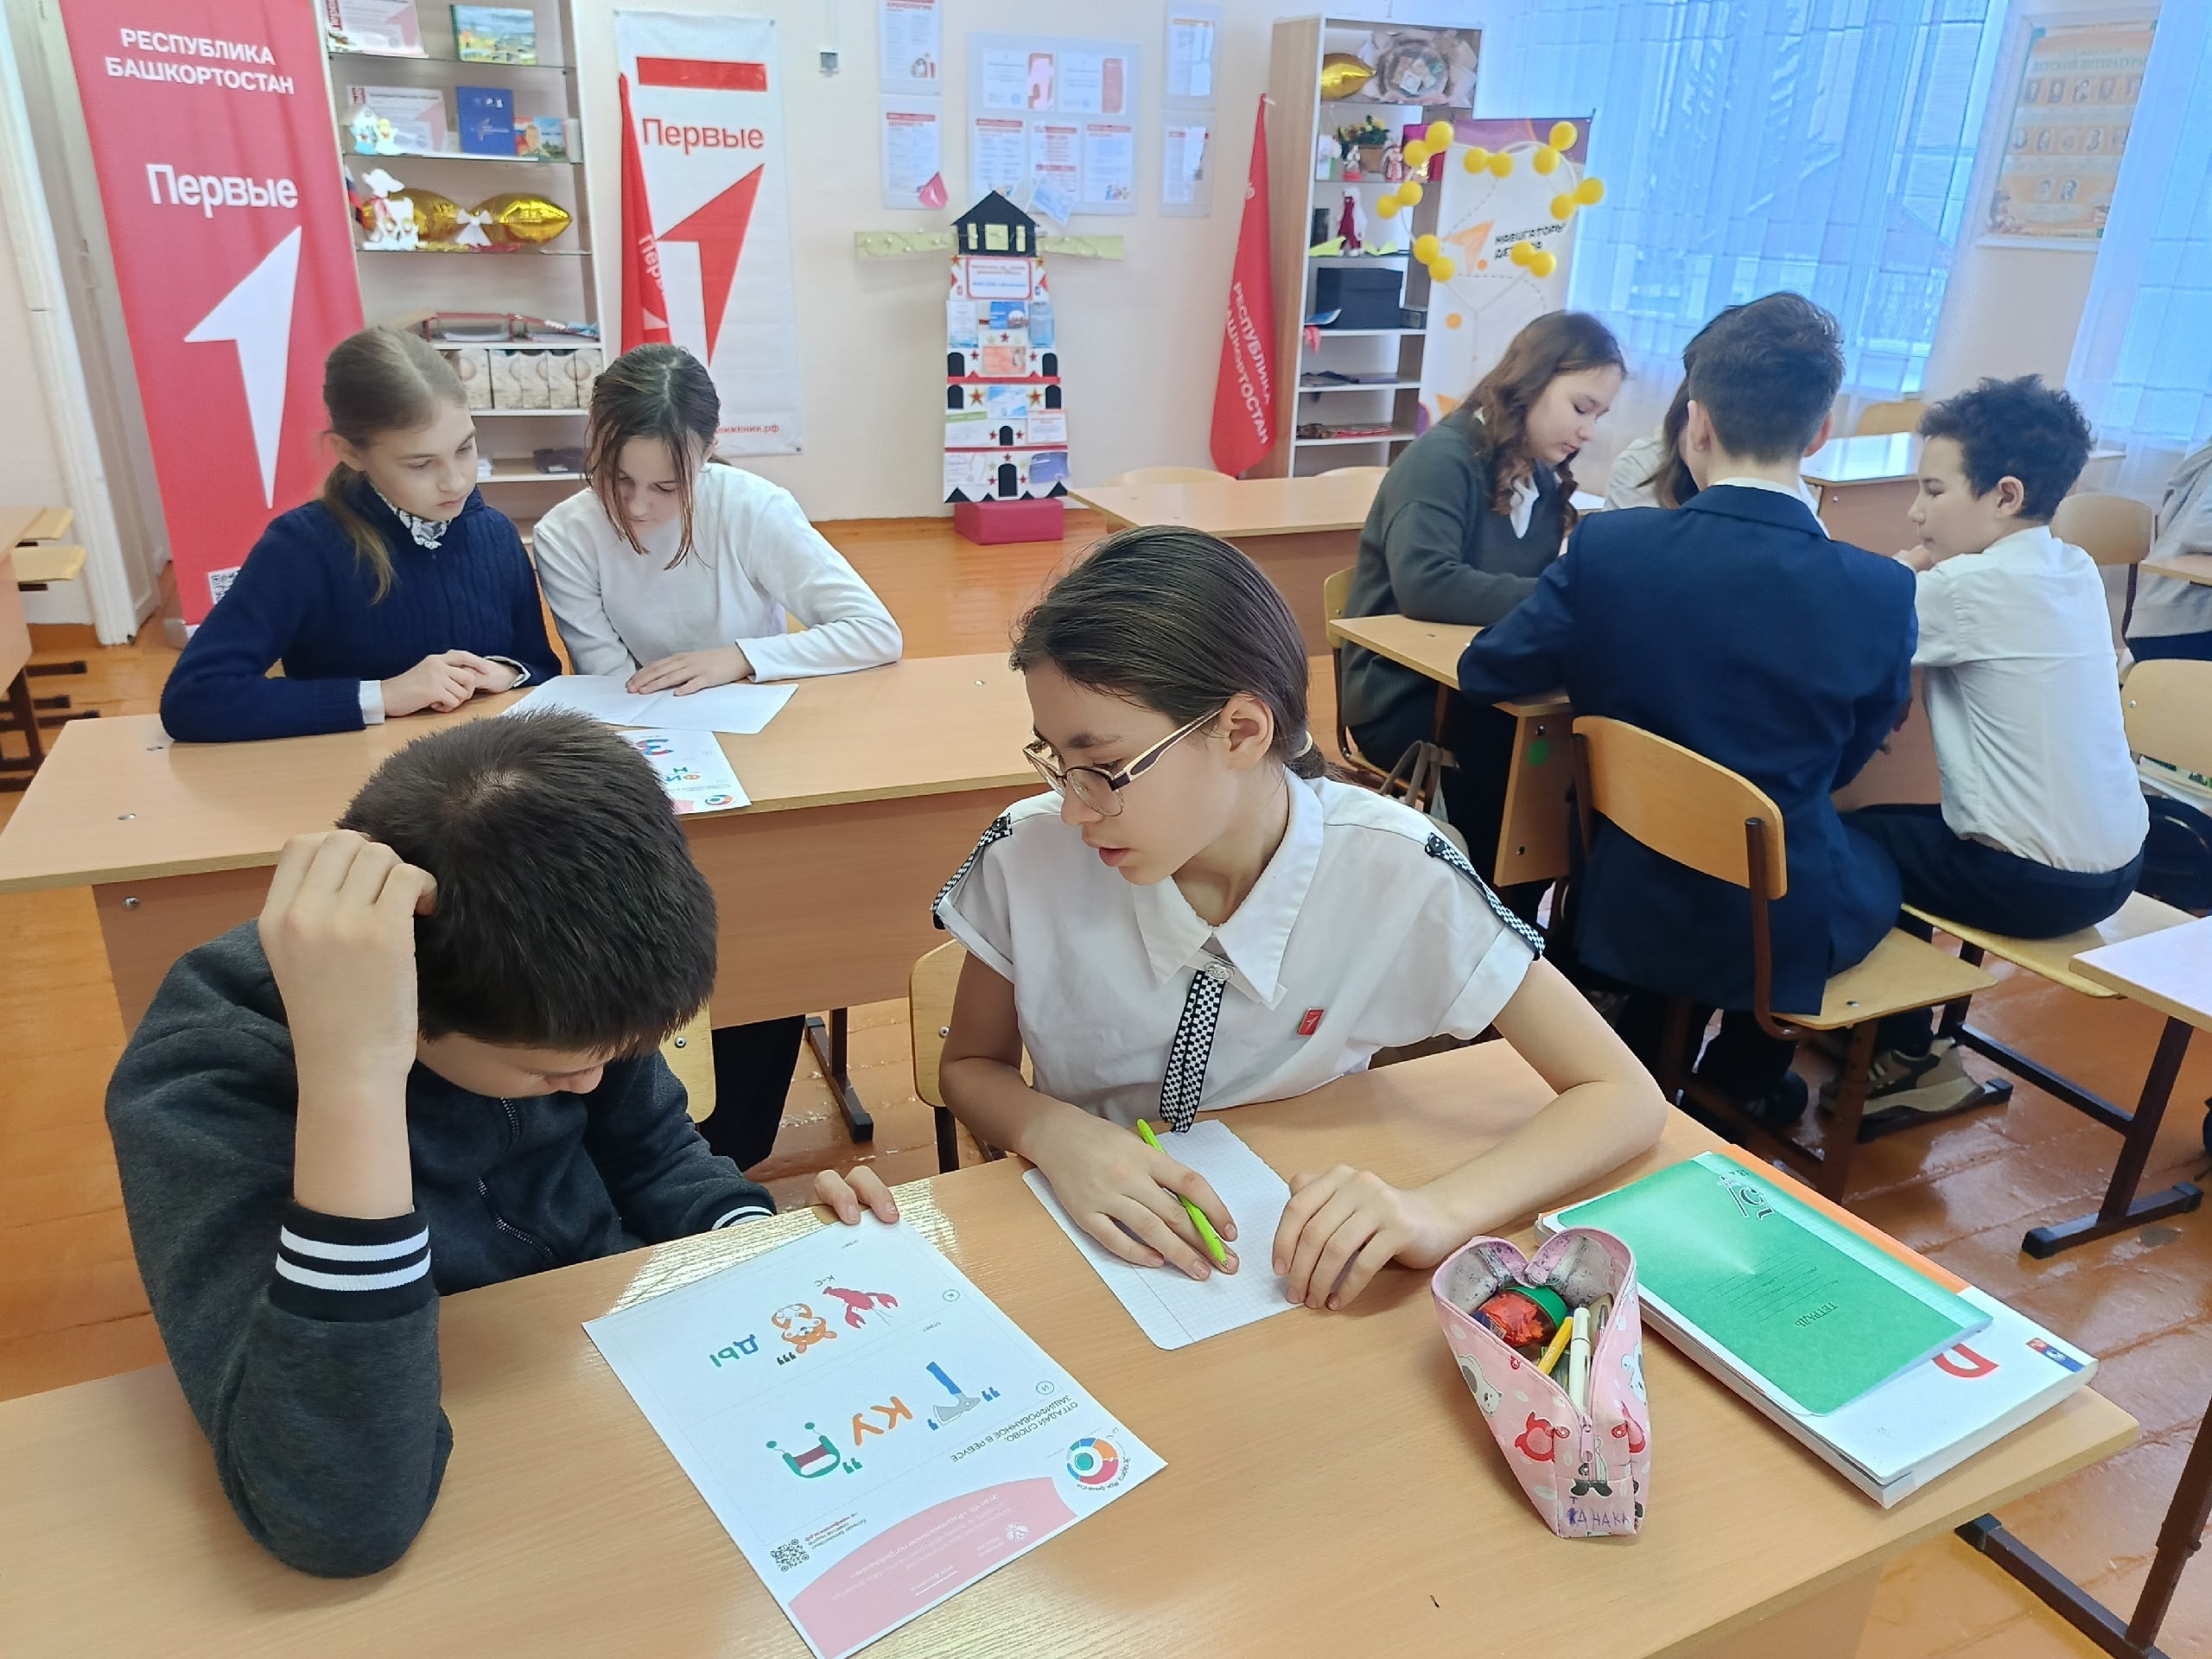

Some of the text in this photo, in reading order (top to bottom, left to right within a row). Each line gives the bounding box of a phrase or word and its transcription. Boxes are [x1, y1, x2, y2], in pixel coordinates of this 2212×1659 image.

[119, 28, 276, 67] РЕСПУБЛИКА
[105, 56, 295, 95] БАШКОРТОСТАН
[642, 118, 766, 156] Первые
[145, 162, 299, 219] Первые
[1226, 308, 1269, 445] АШКОРТОСТАН
[1795, 1302, 1839, 1327] ТЕТРАДЬ
[709, 1333, 760, 1368] ДЫ
[852, 1395, 913, 1446] КУ
[950, 1395, 1072, 1463] ЗАШИФРОВАННОЕ В РЕБУСЕ
[1038, 1402, 1079, 1427] ОТГАДАЙ
